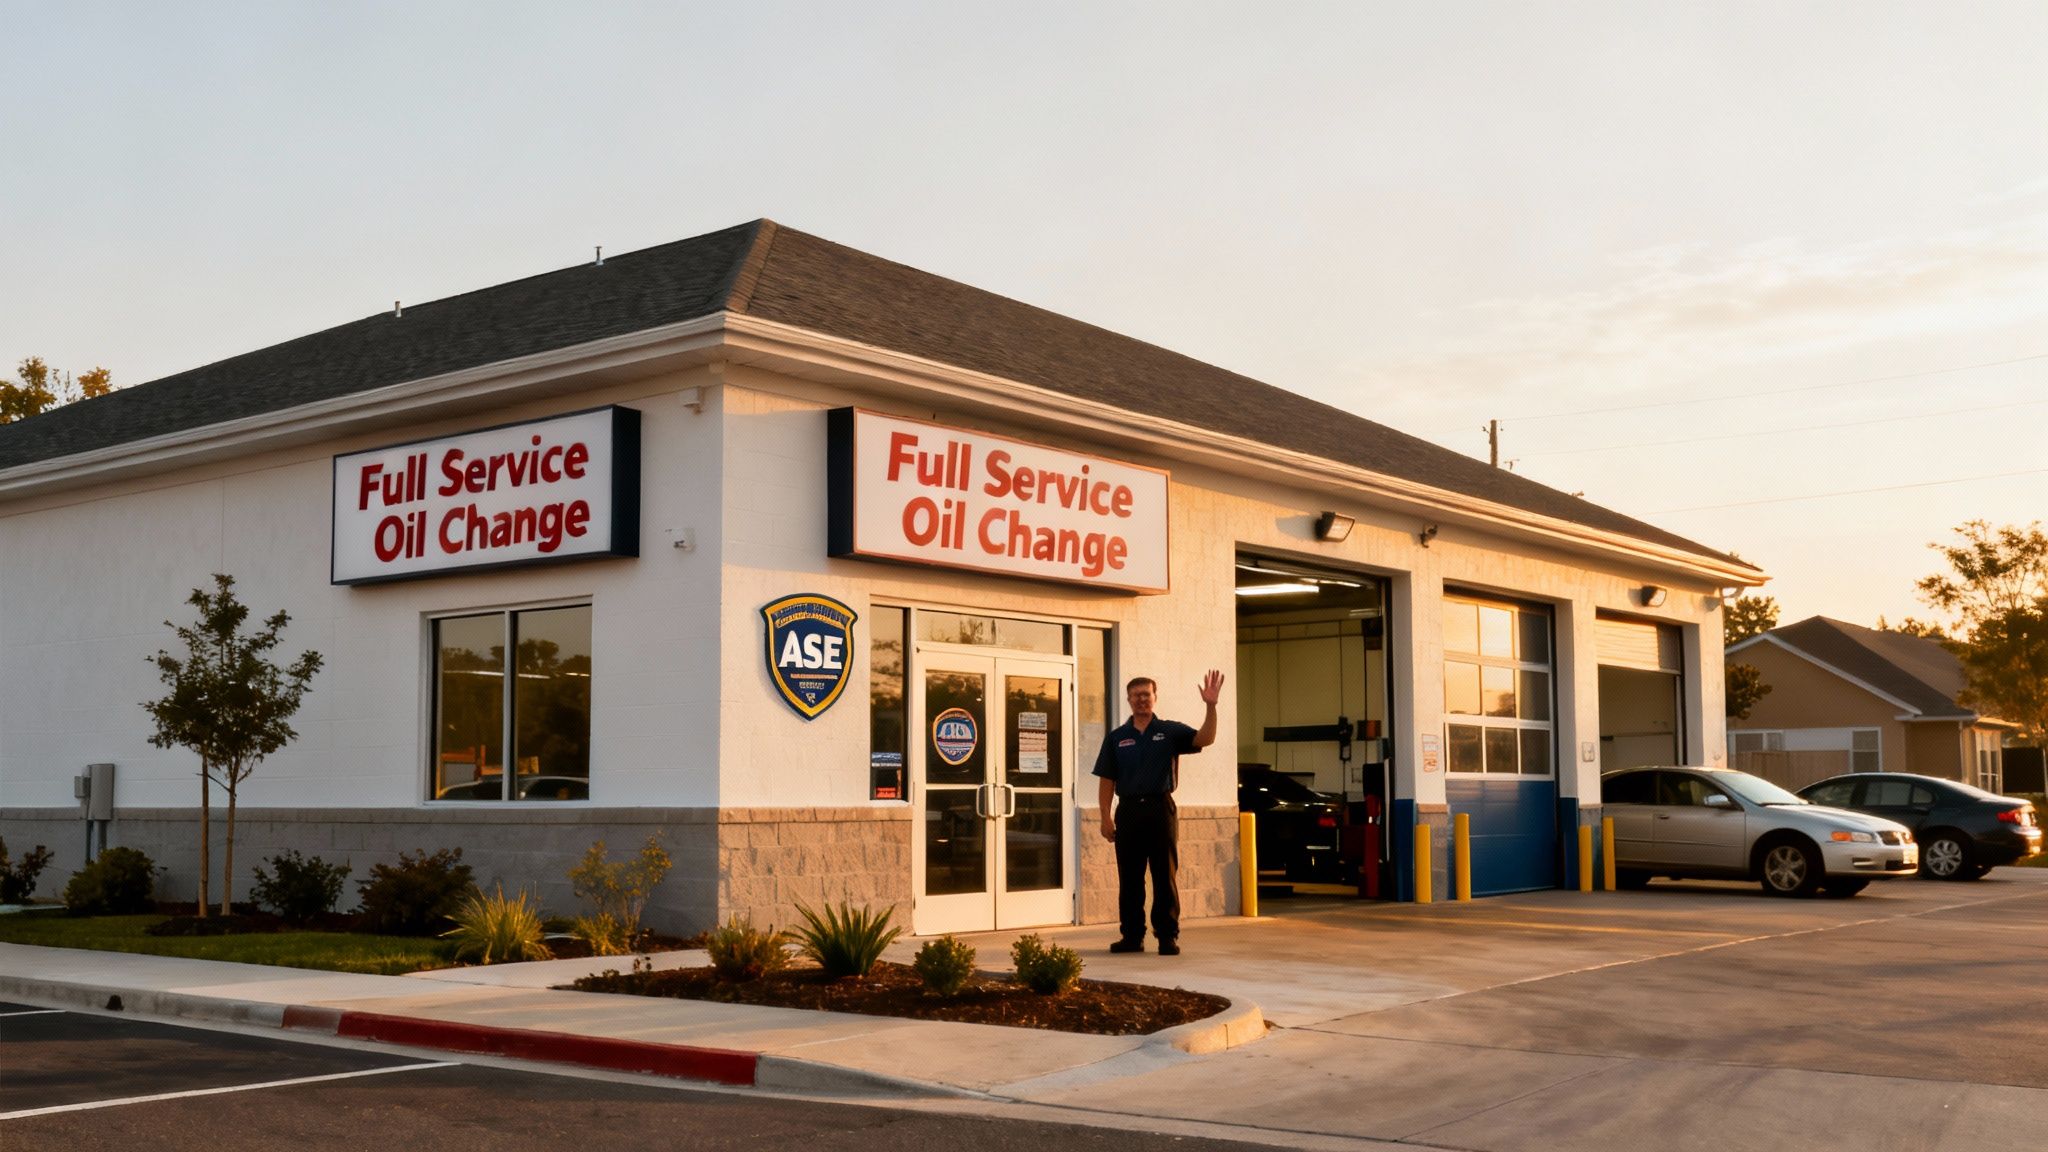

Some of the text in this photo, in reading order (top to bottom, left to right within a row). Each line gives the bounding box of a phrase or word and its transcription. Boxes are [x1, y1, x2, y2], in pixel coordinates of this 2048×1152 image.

[359, 435, 590, 510] Full Service
[887, 431, 1134, 518] Full Service
[374, 500, 590, 562] Oil Change
[902, 496, 1128, 577] Oil Change
[778, 630, 844, 670] ASE
